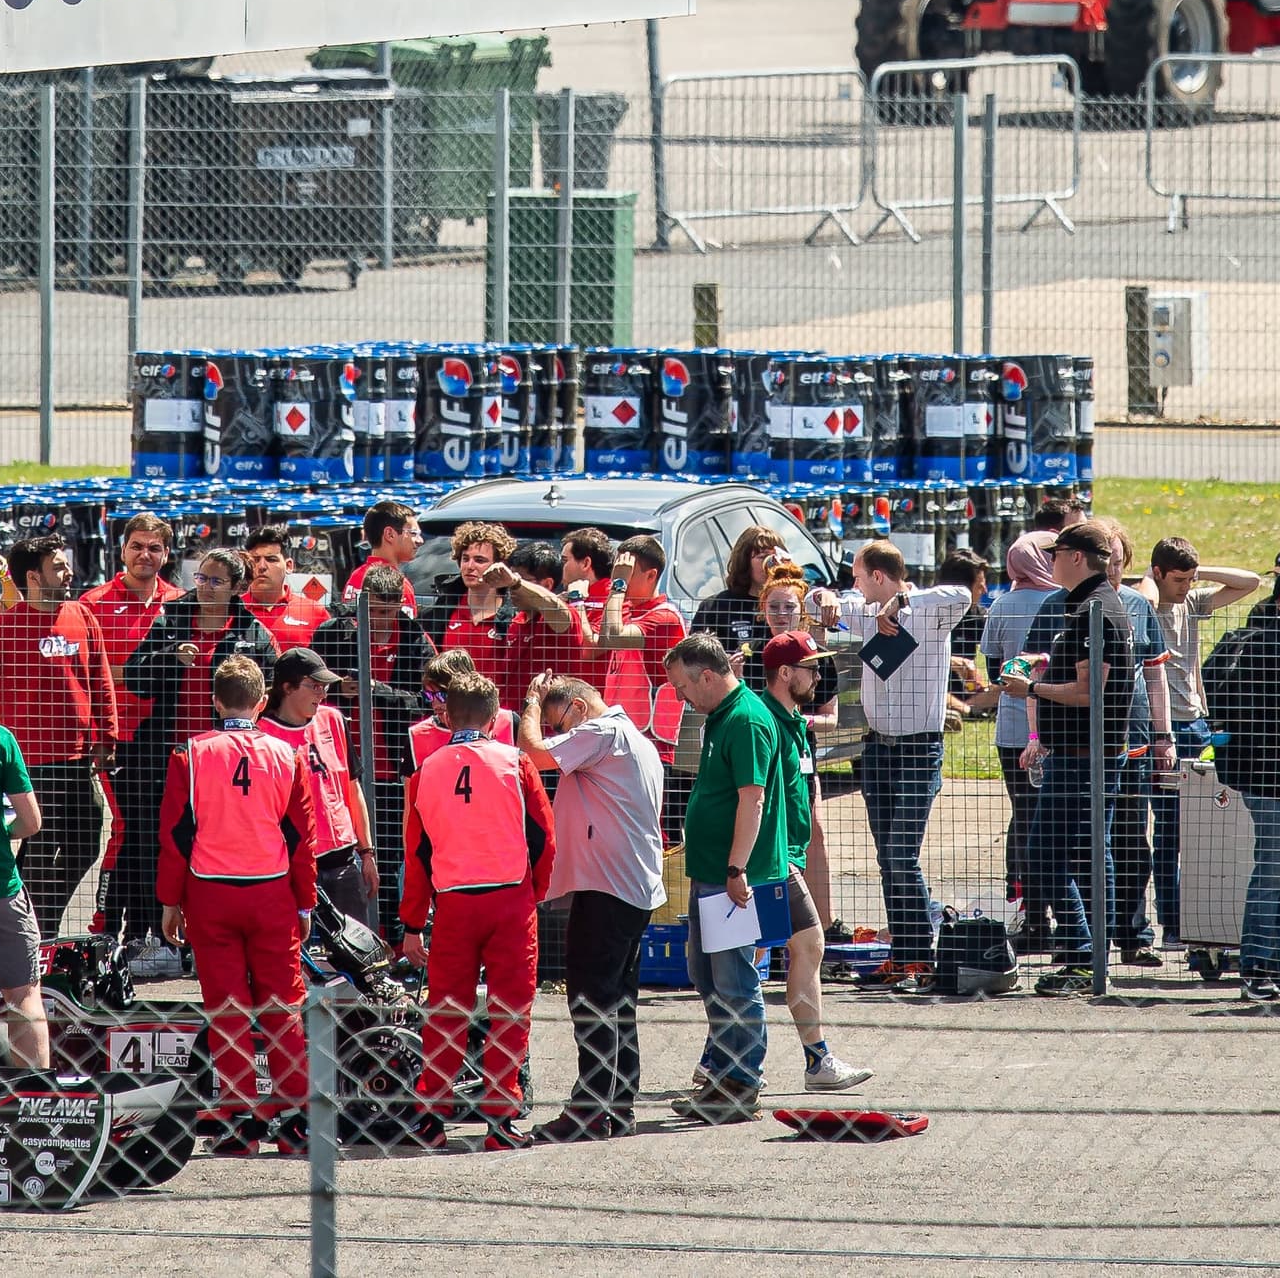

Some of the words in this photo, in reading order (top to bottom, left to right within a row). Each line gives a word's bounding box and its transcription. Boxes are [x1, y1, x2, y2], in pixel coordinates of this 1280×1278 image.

[140, 365, 162, 377] elf
[800, 373, 823, 384] elf
[440, 399, 470, 471] elf
[662, 399, 688, 470] elf
[1004, 404, 1028, 474] elf
[20, 514, 45, 528] elf
[232, 756, 252, 796] 4
[454, 765, 472, 804] 4
[117, 1035, 146, 1073] 4
[18, 1097, 99, 1117] TYGAVAC
[22, 1136, 91, 1150] easycomposites
